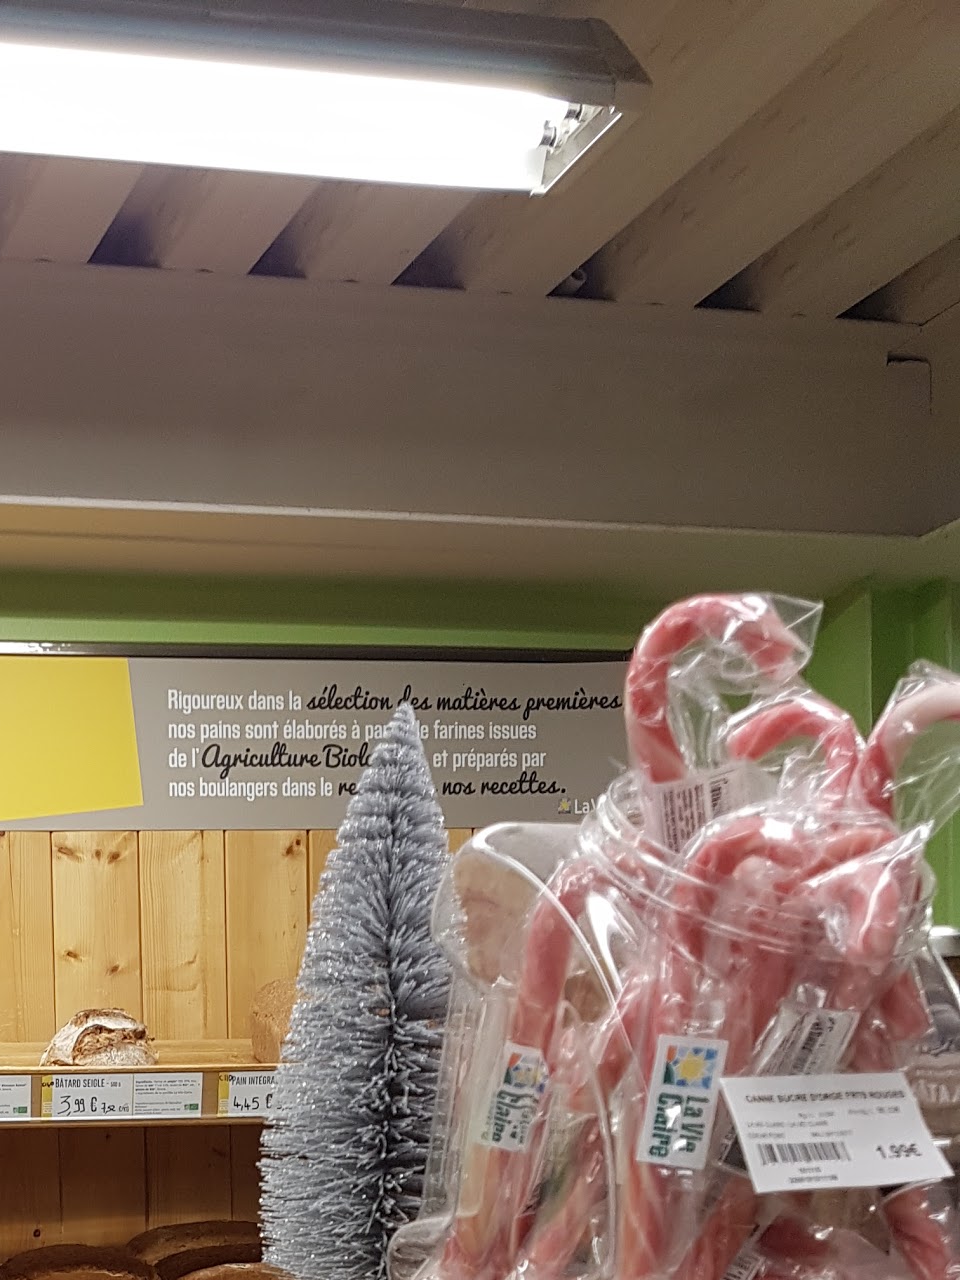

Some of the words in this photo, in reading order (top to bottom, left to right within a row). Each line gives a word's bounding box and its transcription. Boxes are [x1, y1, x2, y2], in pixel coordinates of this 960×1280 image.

[168, 689, 244, 714] Rigoureux
[248, 690, 284, 710] dans
[289, 690, 301, 710] la
[307, 684, 393, 710] sélection
[437, 687, 521, 711] matières
[523, 687, 622, 720] premières
[168, 723, 195, 739] nos
[200, 721, 241, 742] pains
[245, 721, 279, 739] sont
[283, 719, 347, 739] élaborés
[351, 720, 361, 739] à
[434, 720, 485, 739] farines
[489, 722, 537, 739] issues
[169, 748, 187, 768] de
[433, 752, 448, 768] et
[452, 748, 517, 771] préparés
[522, 751, 546, 771] par
[169, 781, 195, 797] nos
[200, 777, 278, 801] boulangers
[282, 778, 316, 797] dans
[321, 777, 332, 796] le
[442, 780, 476, 796] nos
[481, 771, 566, 795] recettes.
[82, 1078, 105, 1088] SEIGLE
[231, 1076, 247, 1086] PAIN
[57, 1095, 86, 1116] 3,99
[233, 1095, 260, 1111] 4,45
